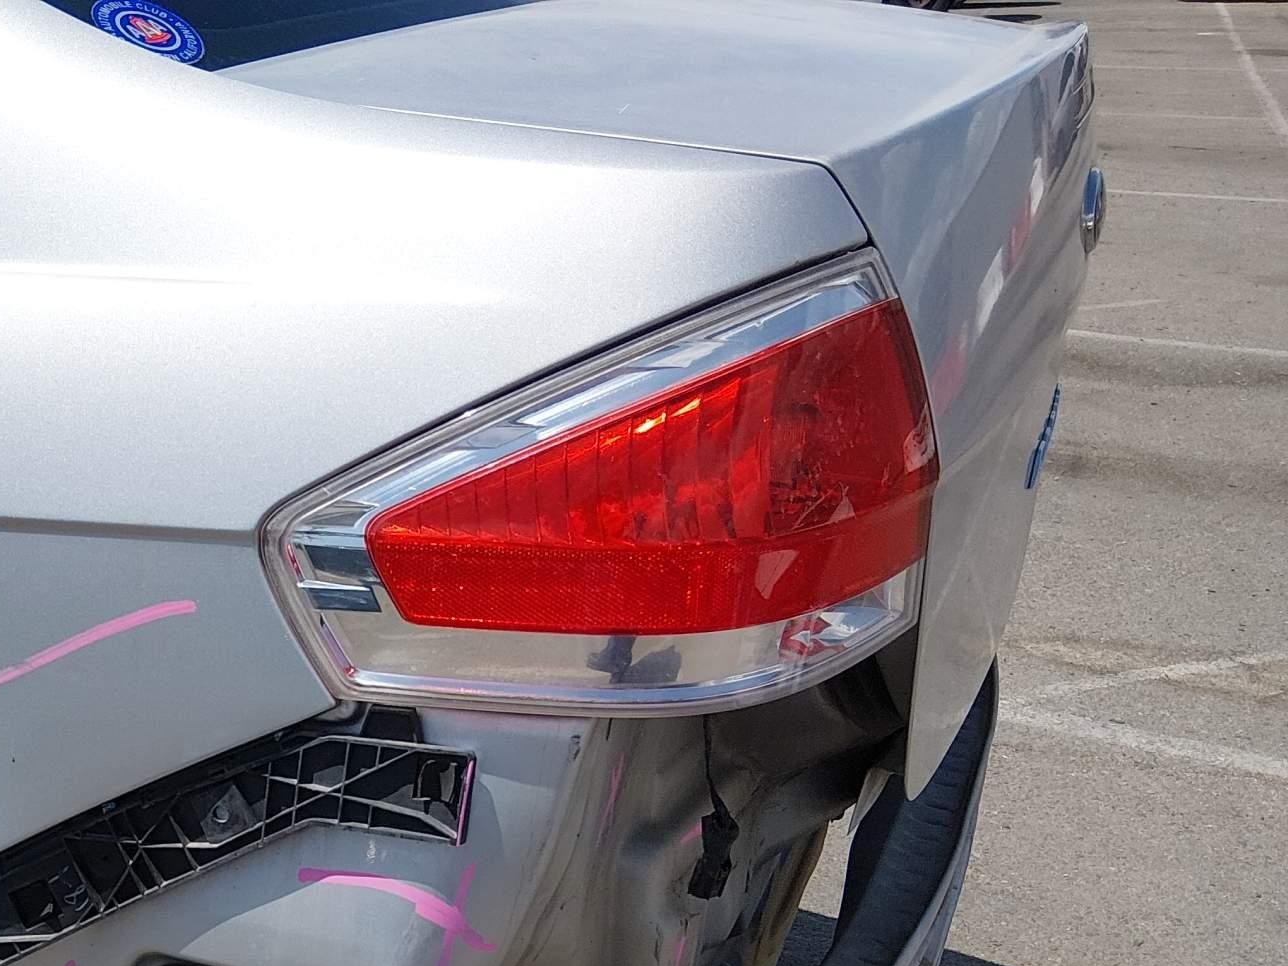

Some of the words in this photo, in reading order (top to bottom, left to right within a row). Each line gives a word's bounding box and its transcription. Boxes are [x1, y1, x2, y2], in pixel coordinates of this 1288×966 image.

[98, 0, 133, 31] AUTOMOBILE
[135, 2, 168, 19] CLUB
[126, 19, 168, 39] AAA
[175, 21, 199, 60] CALIFORNIA
